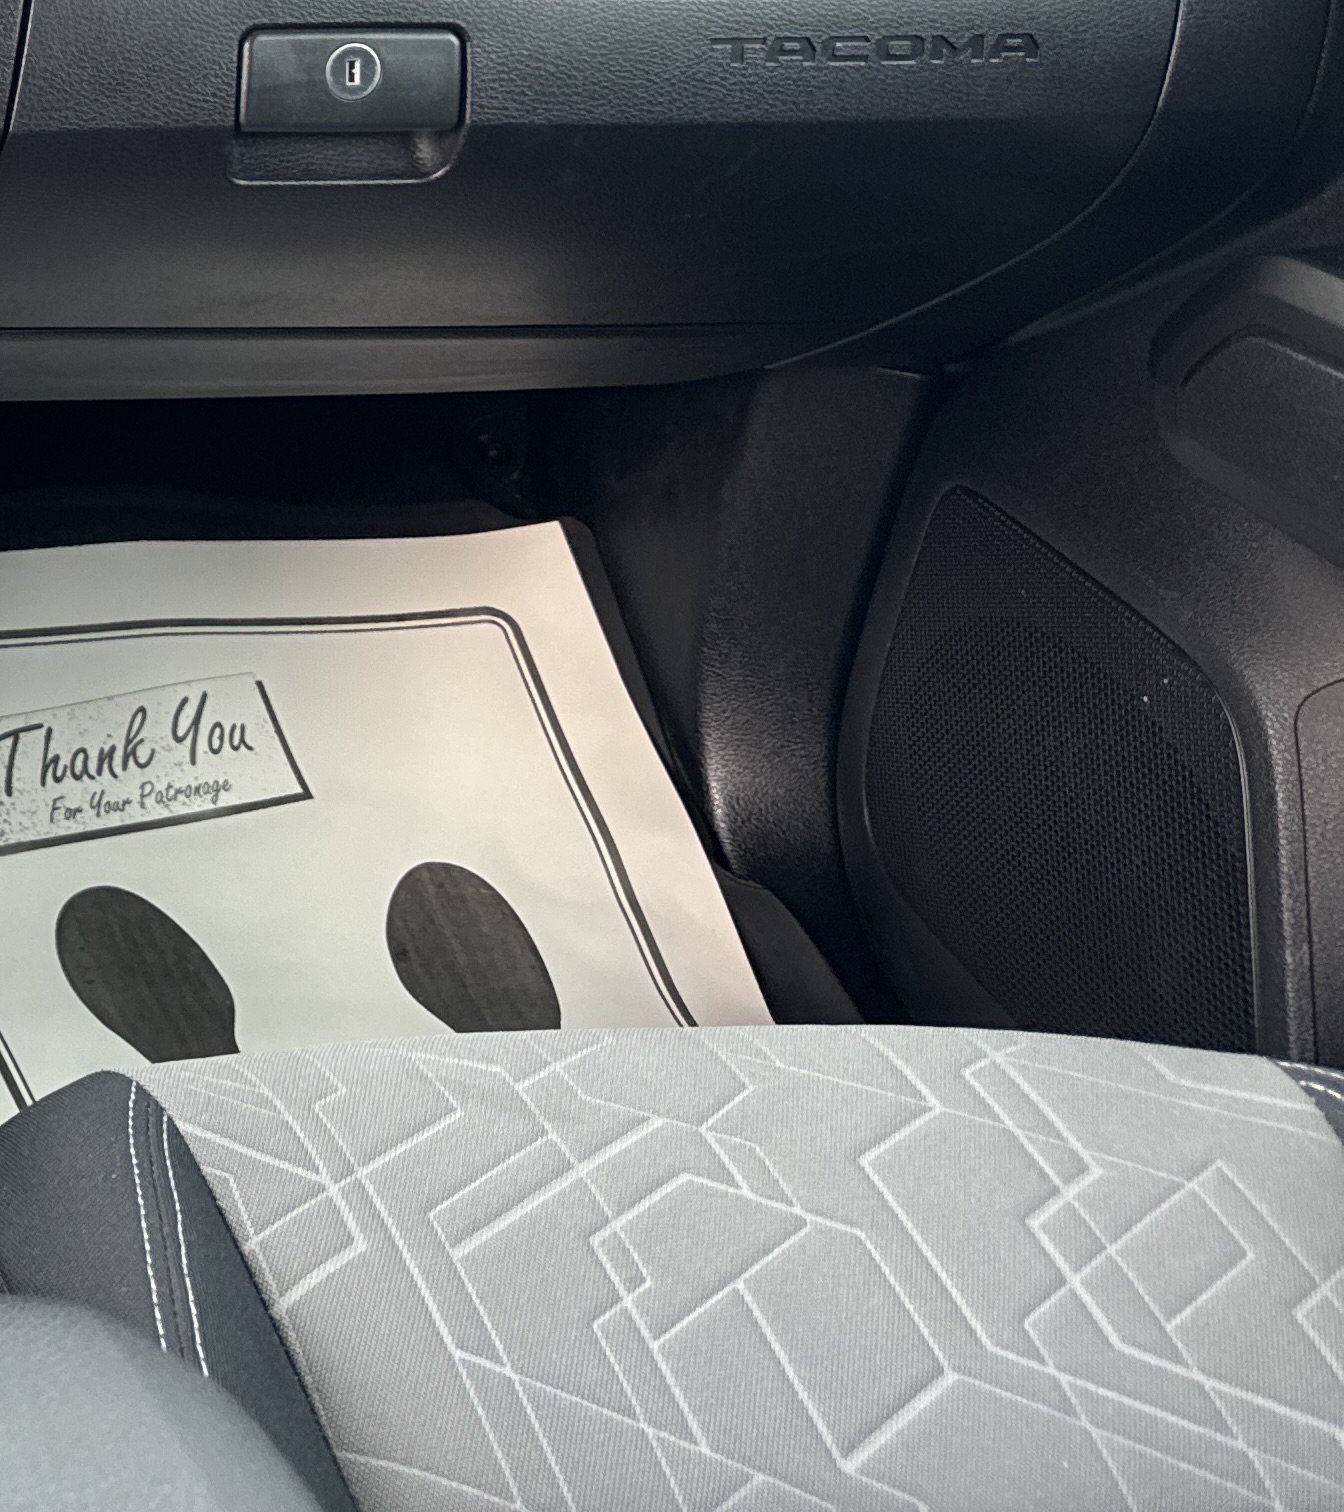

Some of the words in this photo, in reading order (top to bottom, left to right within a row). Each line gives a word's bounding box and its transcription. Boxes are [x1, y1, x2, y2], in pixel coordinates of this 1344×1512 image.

[711, 34, 1040, 67] TACOMA
[172, 691, 254, 766] You
[50, 796, 83, 823] For
[90, 789, 132, 815] Your
[139, 779, 232, 810] Patronage
